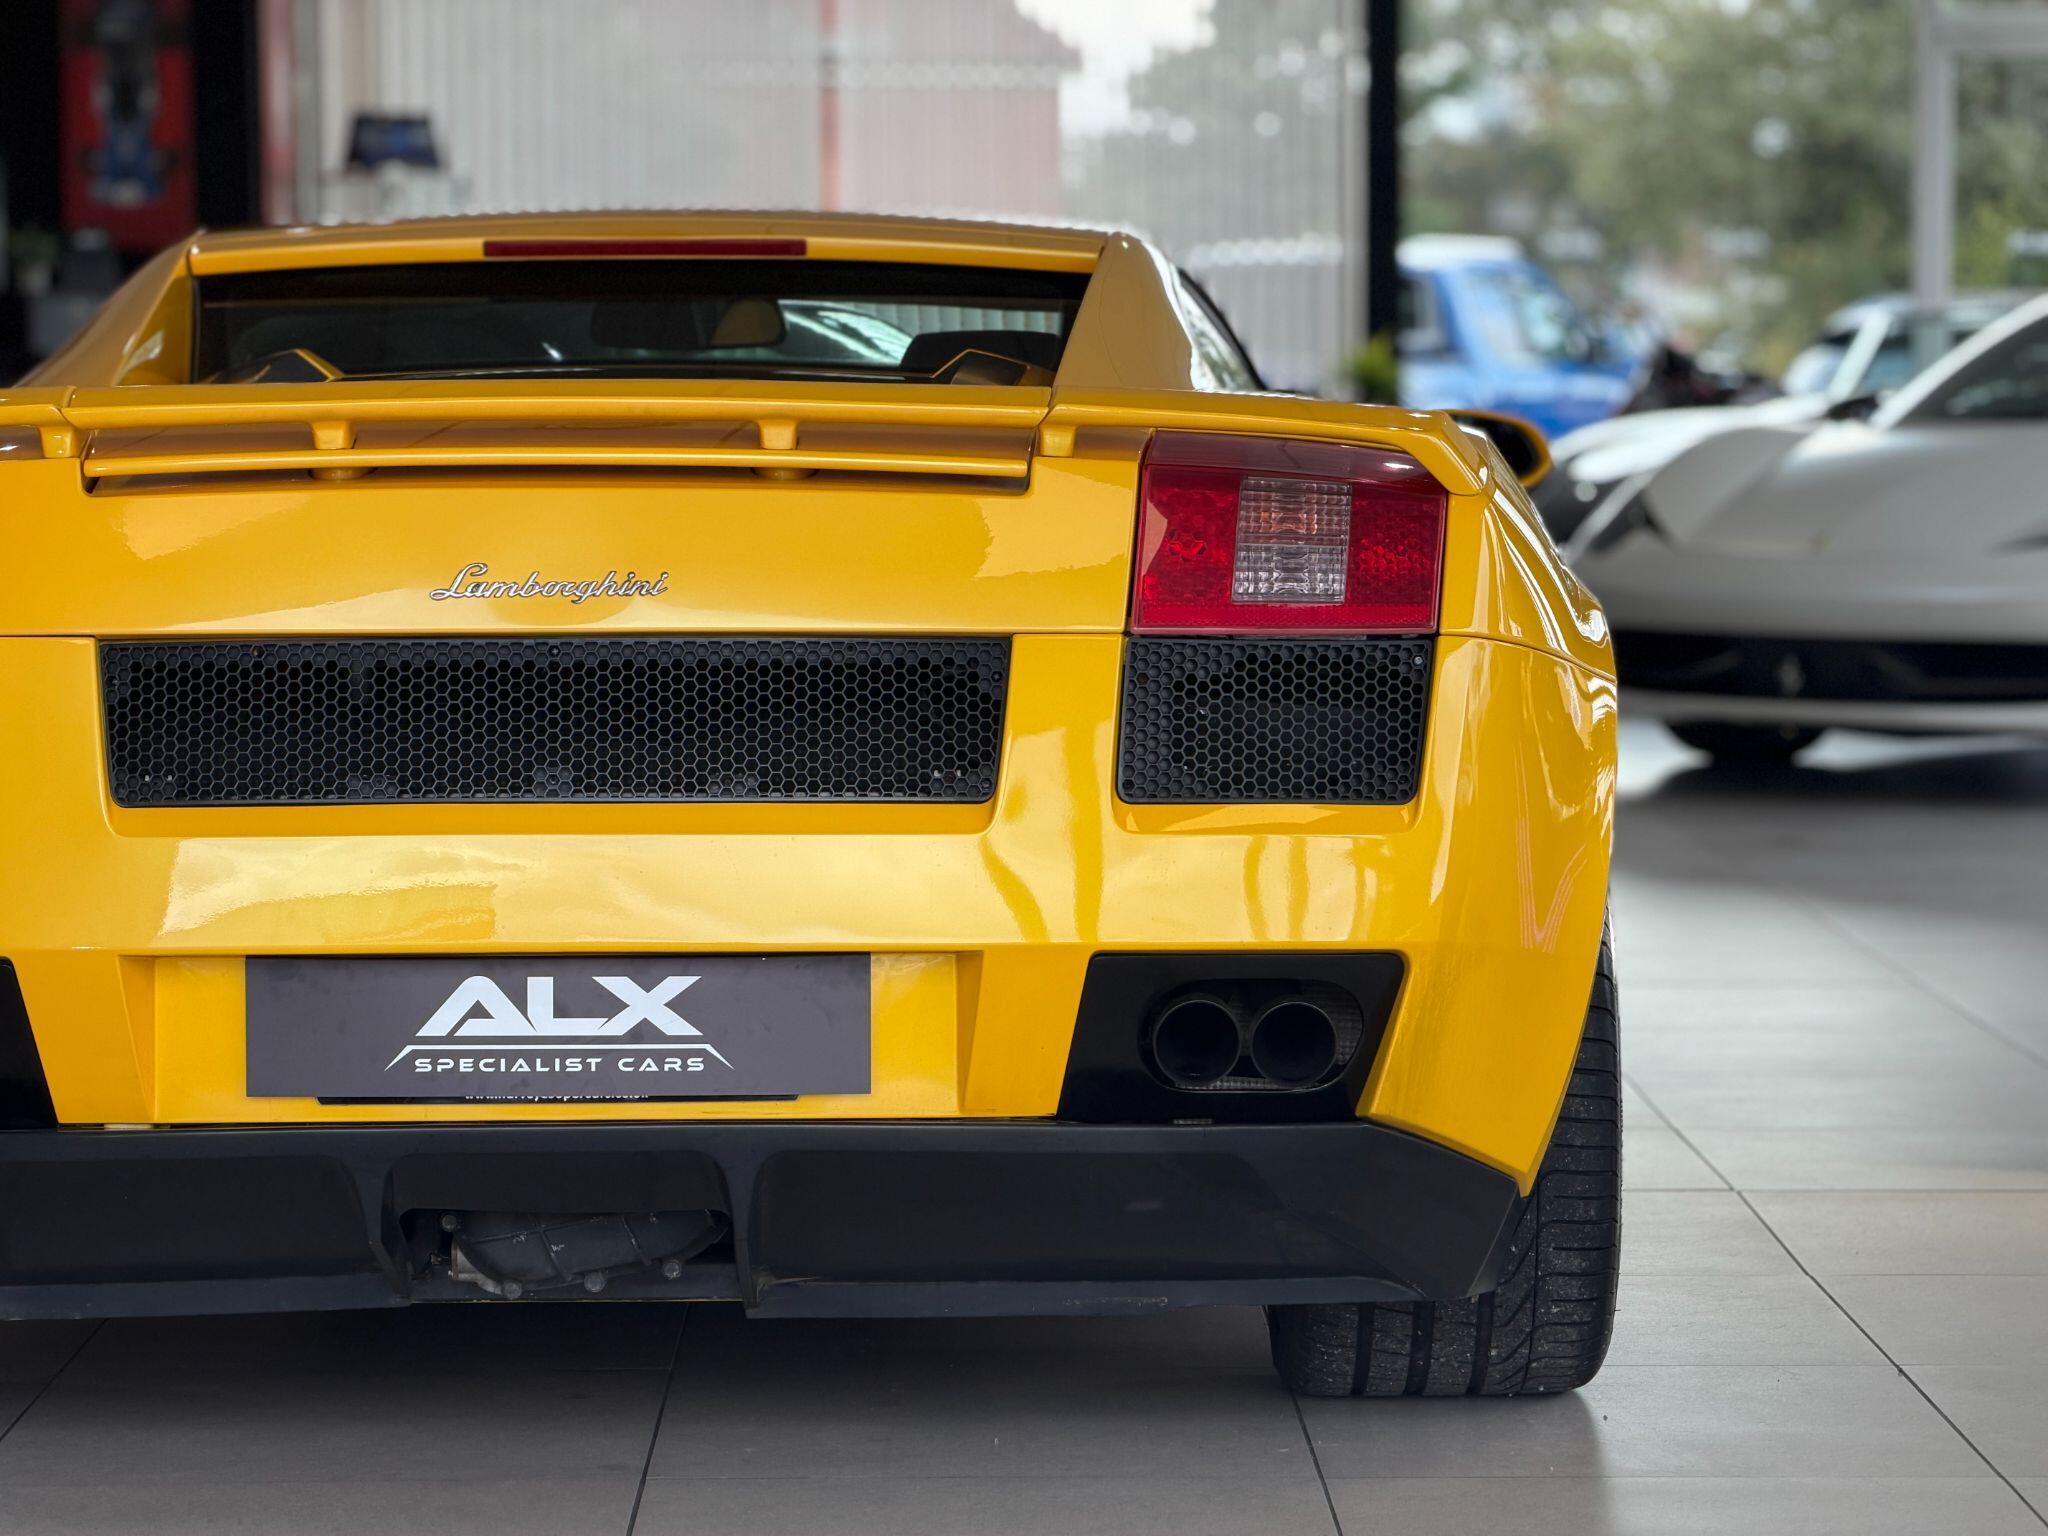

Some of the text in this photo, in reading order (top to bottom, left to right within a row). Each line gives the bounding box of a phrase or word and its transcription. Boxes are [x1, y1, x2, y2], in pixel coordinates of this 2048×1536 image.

[429, 562, 669, 604] Lamborghini
[415, 975, 704, 1037] ALX
[414, 1057, 705, 1073] SPECIALIST CARS
